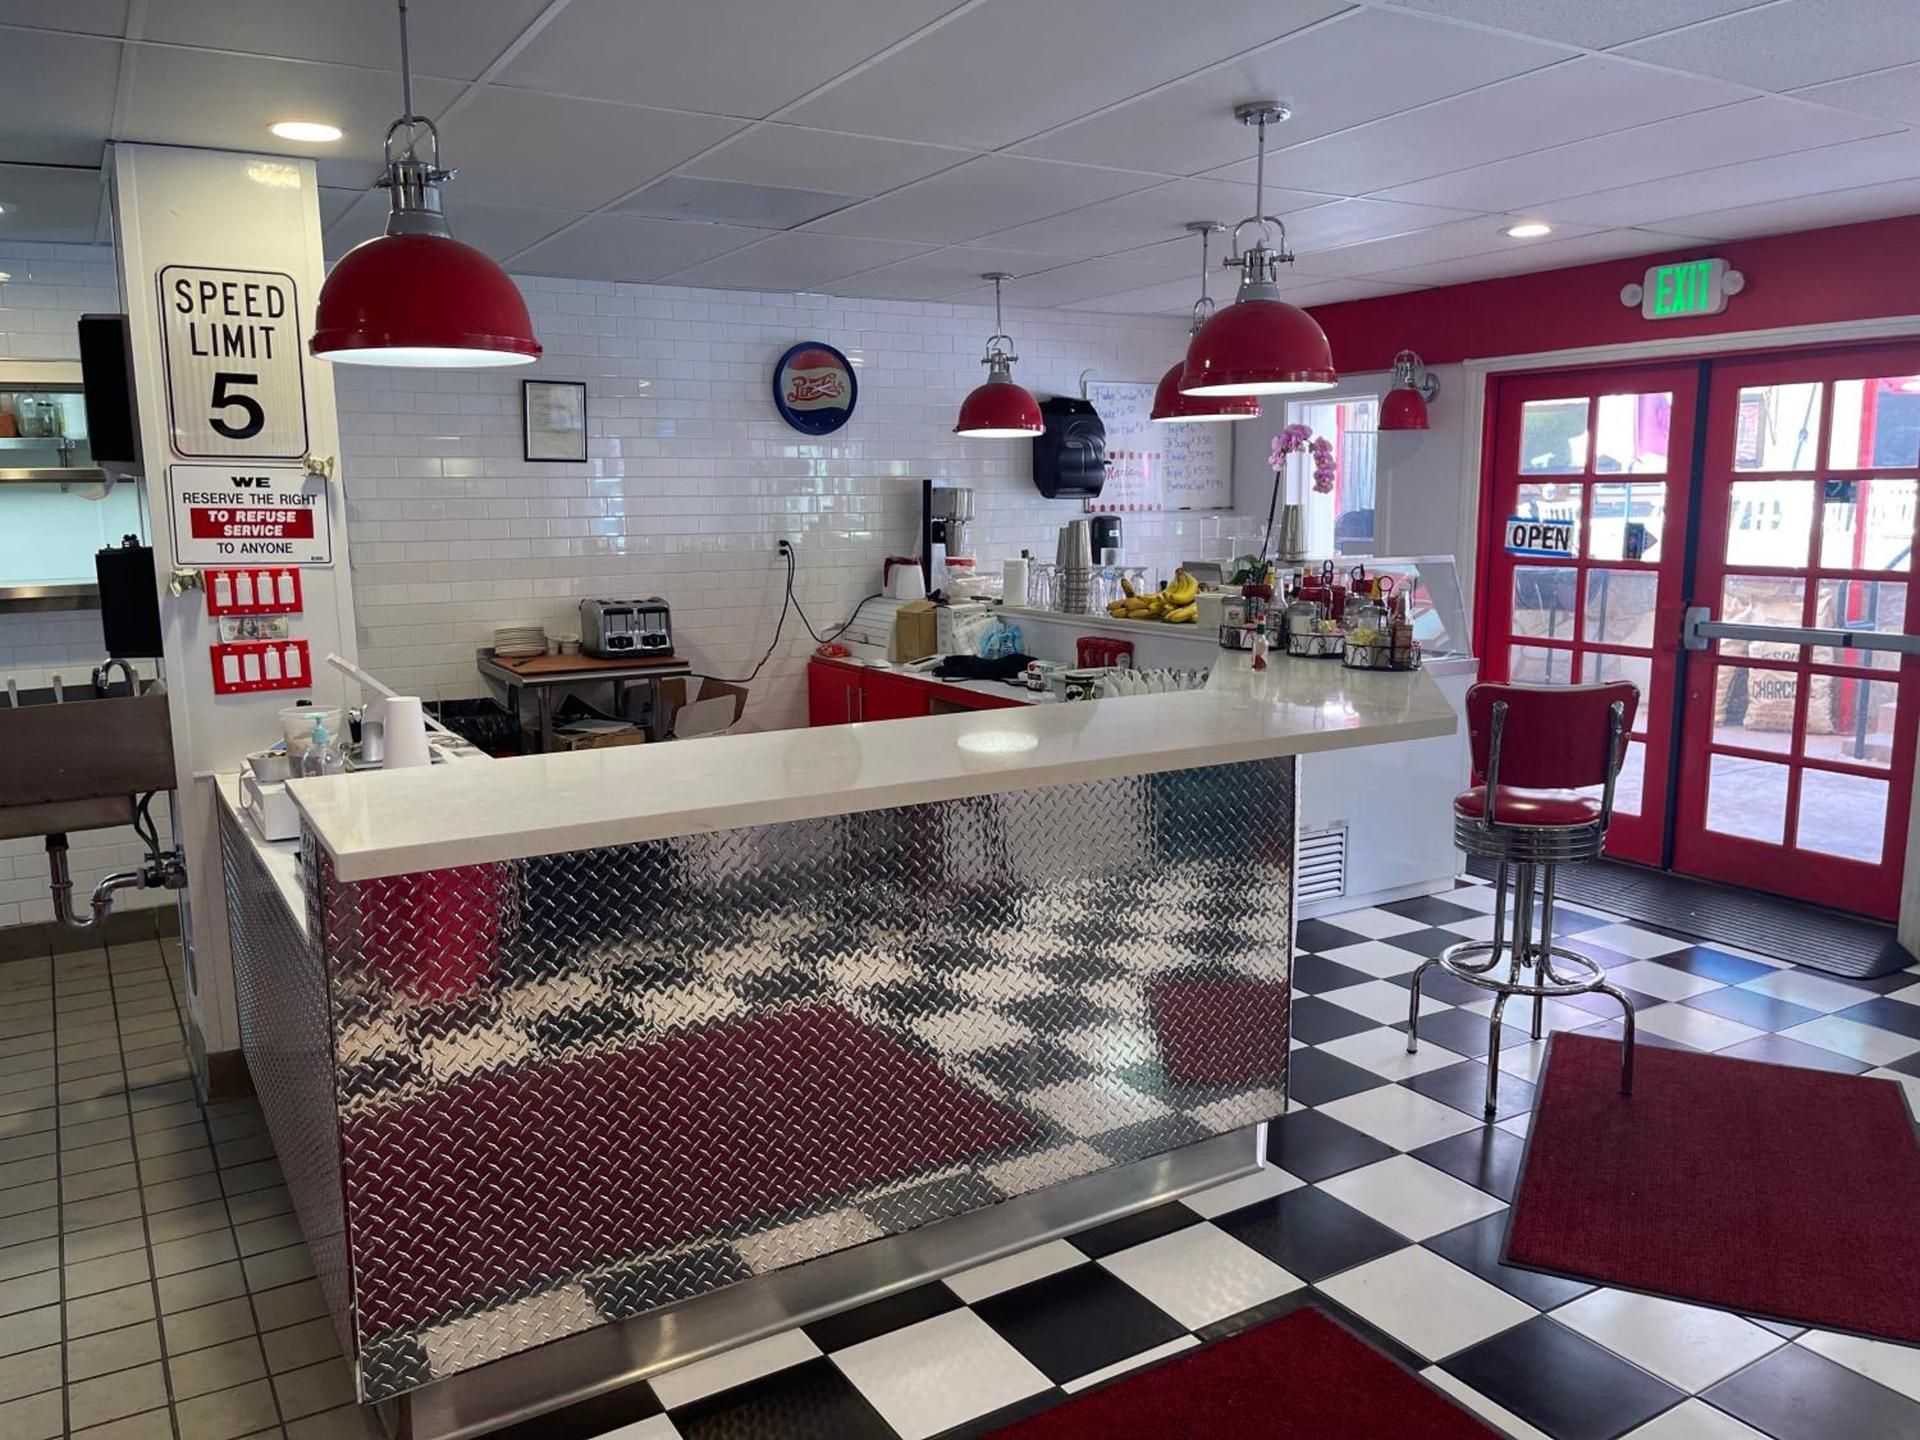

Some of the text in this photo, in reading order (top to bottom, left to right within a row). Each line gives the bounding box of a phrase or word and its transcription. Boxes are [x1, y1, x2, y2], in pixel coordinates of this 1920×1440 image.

[1655, 262, 1712, 315] EXIT
[175, 279, 285, 318] SPEED
[190, 322, 275, 359] LIMIT
[209, 372, 265, 439] 5
[231, 476, 271, 488] WE
[182, 492, 317, 505] RESERVE THE RIGHT
[208, 510, 297, 523] TO REFUSE
[223, 525, 283, 537] SERVICE
[1512, 525, 1570, 551] OPEN
[216, 542, 293, 554] TO ANYONE
